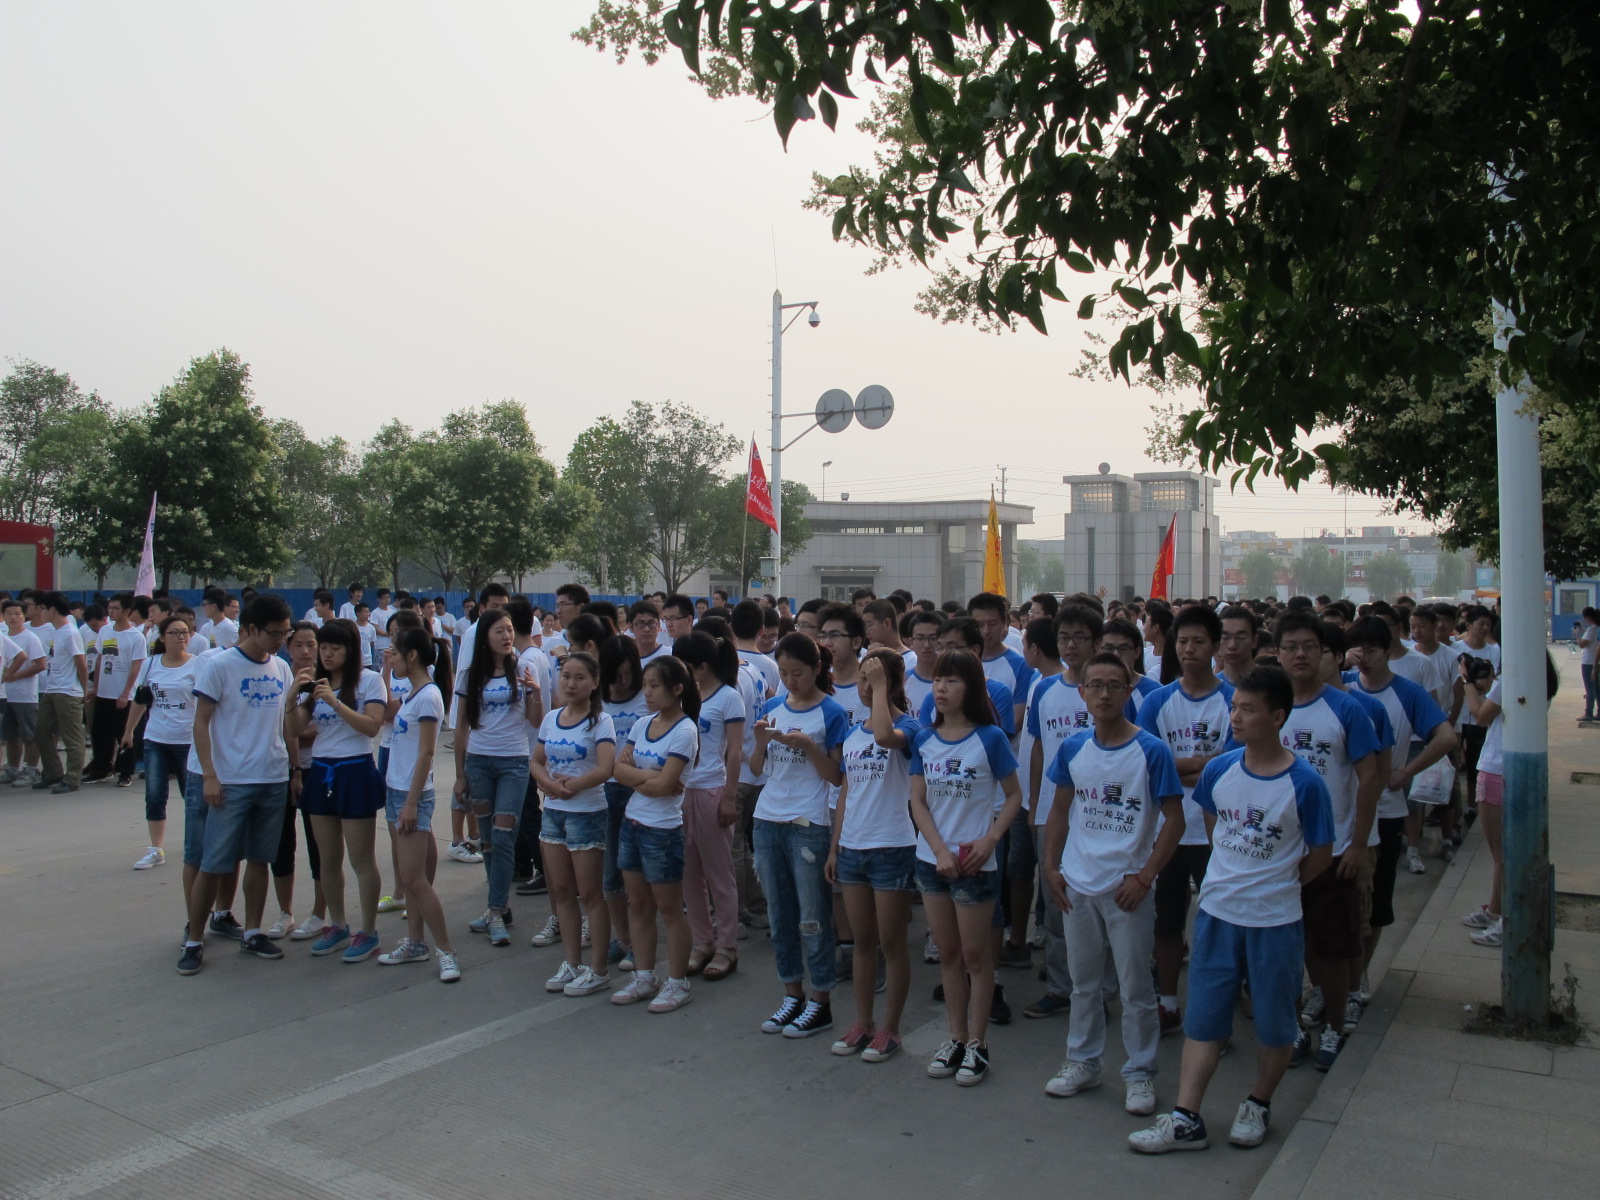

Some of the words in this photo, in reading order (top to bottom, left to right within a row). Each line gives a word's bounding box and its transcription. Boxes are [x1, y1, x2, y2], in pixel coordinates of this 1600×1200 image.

[1083, 806, 1136, 826] 我们一起毕业
[1085, 820, 1136, 834] CLASS:ONE
[1221, 839, 1274, 861] CLASS:ONE
